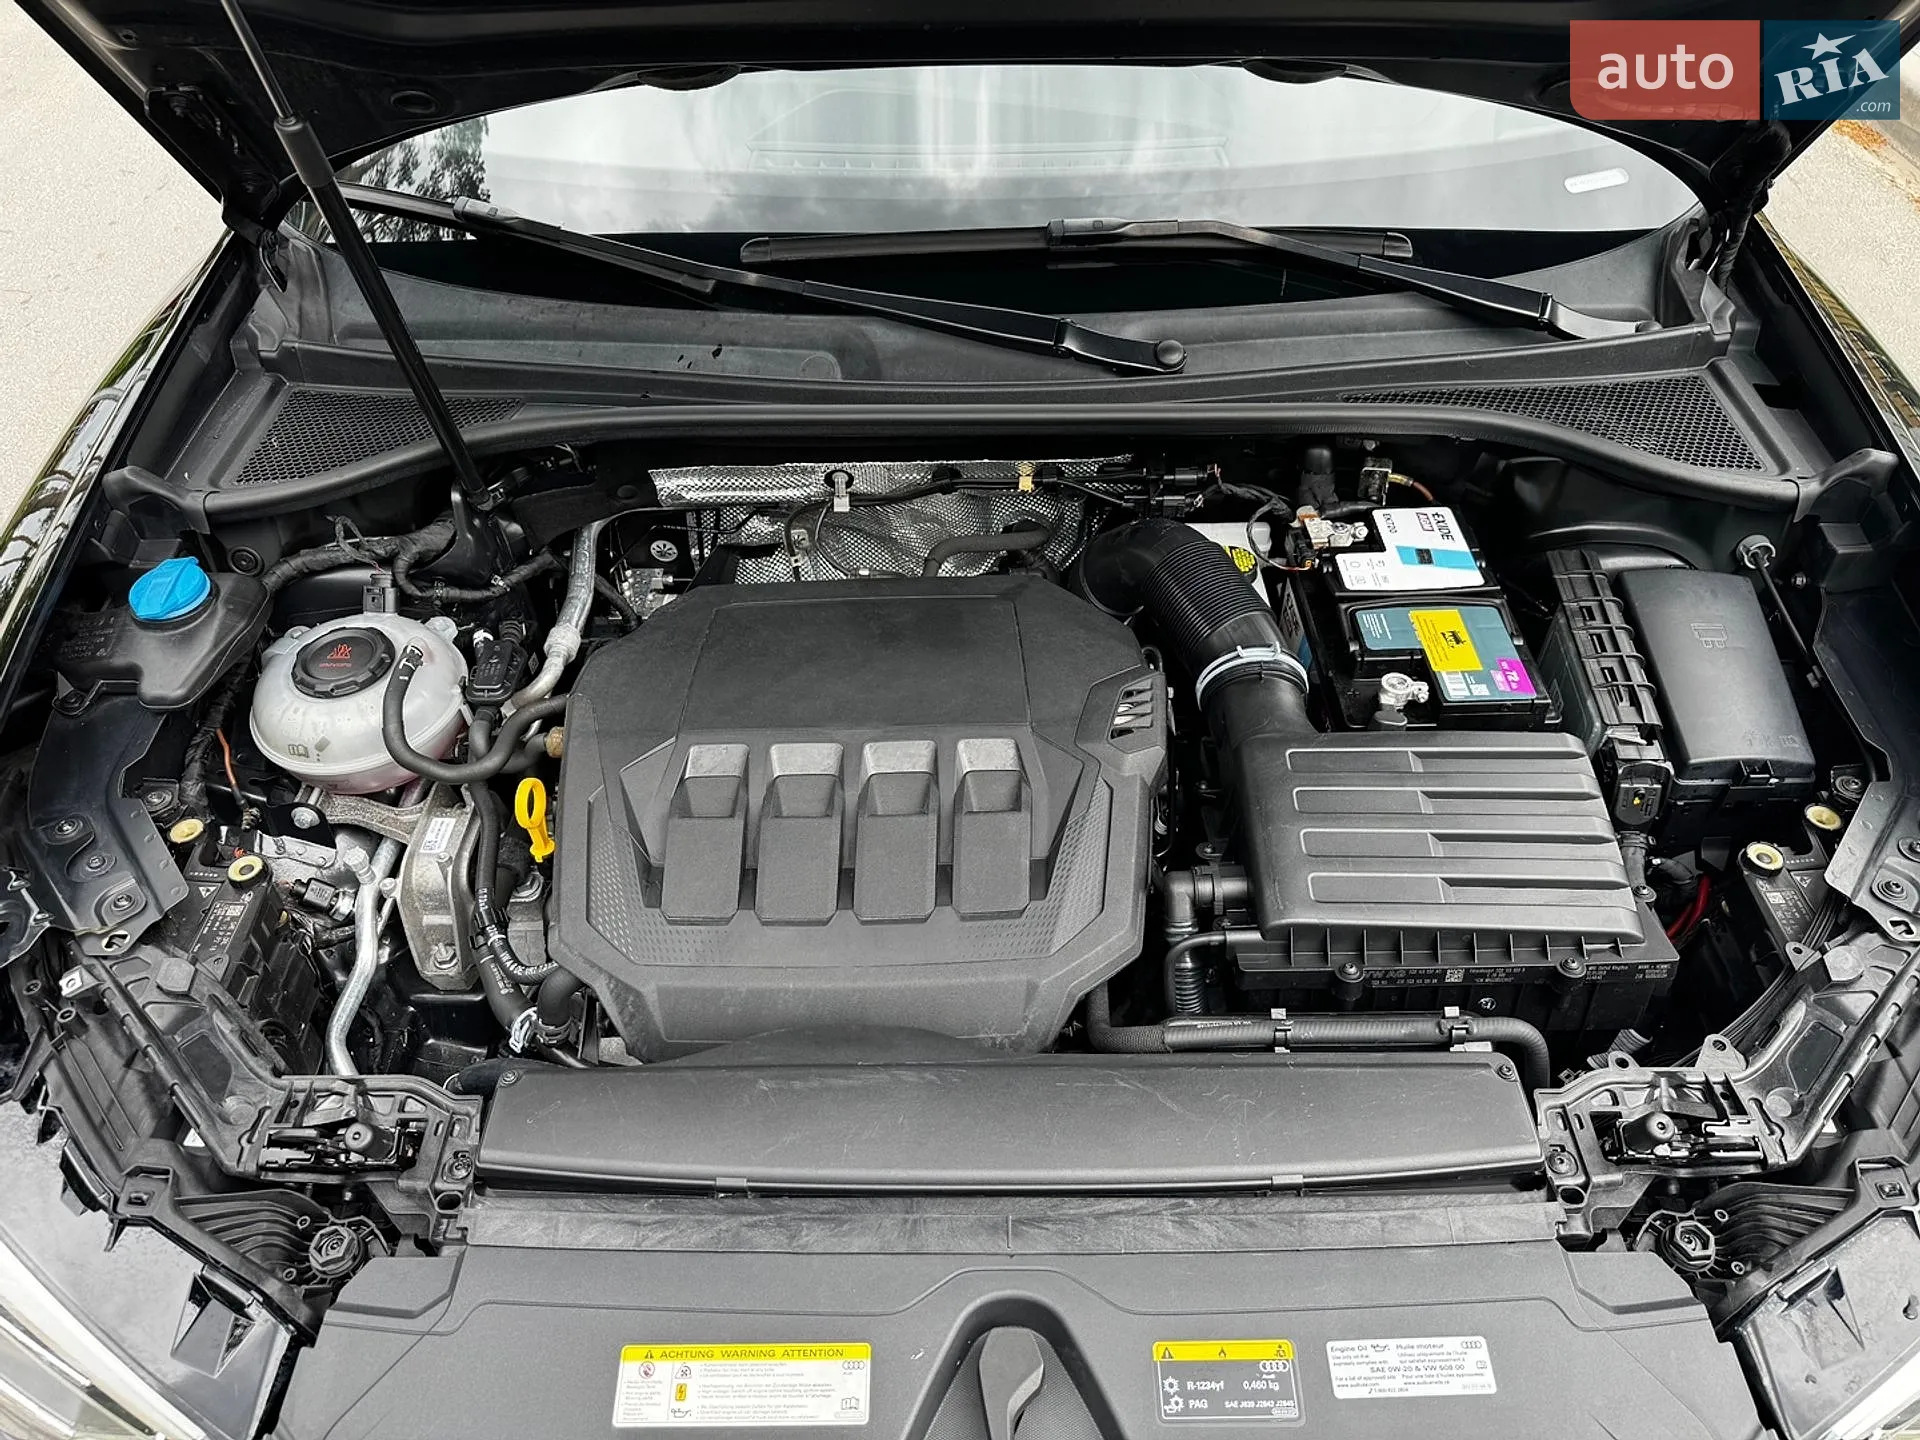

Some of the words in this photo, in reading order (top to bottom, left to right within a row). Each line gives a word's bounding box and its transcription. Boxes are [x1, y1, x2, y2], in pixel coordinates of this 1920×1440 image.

[1432, 512, 1455, 541] EXIDE
[660, 1350, 715, 1359] ACHTUNG
[721, 1349, 776, 1358] WARNING
[782, 1348, 844, 1357] ATTENTION
[1370, 1366, 1386, 1374] SAE
[1188, 1399, 1208, 1409] PAG
